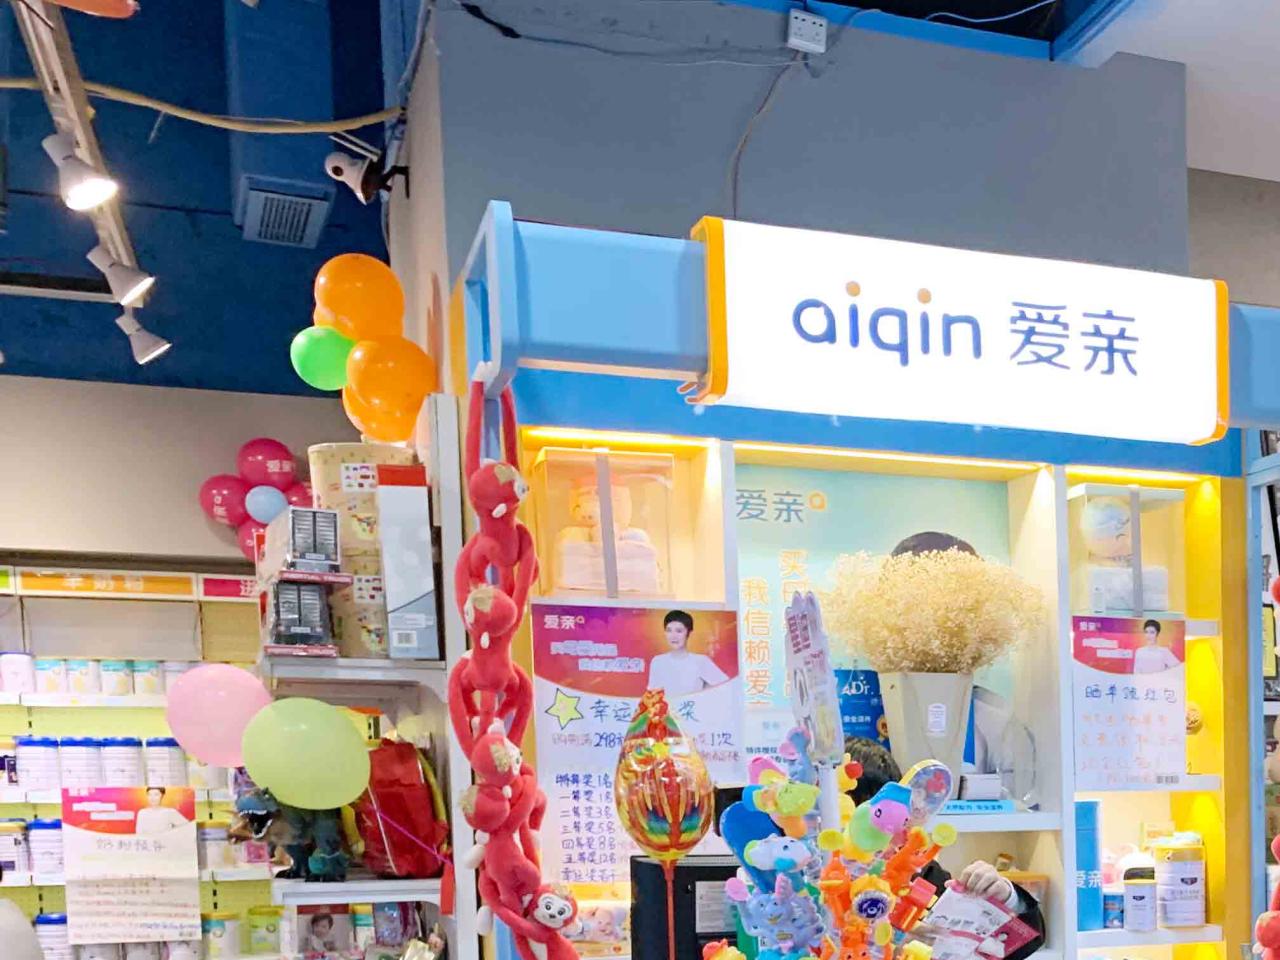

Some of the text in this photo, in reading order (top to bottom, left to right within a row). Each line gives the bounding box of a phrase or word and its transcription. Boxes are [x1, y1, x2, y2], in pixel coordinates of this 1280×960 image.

[792, 280, 1140, 377] aiqin 爱亲
[735, 488, 805, 524] 爱亲
[544, 614, 576, 630] 爱亲
[741, 576, 773, 706] 我信赖爱
